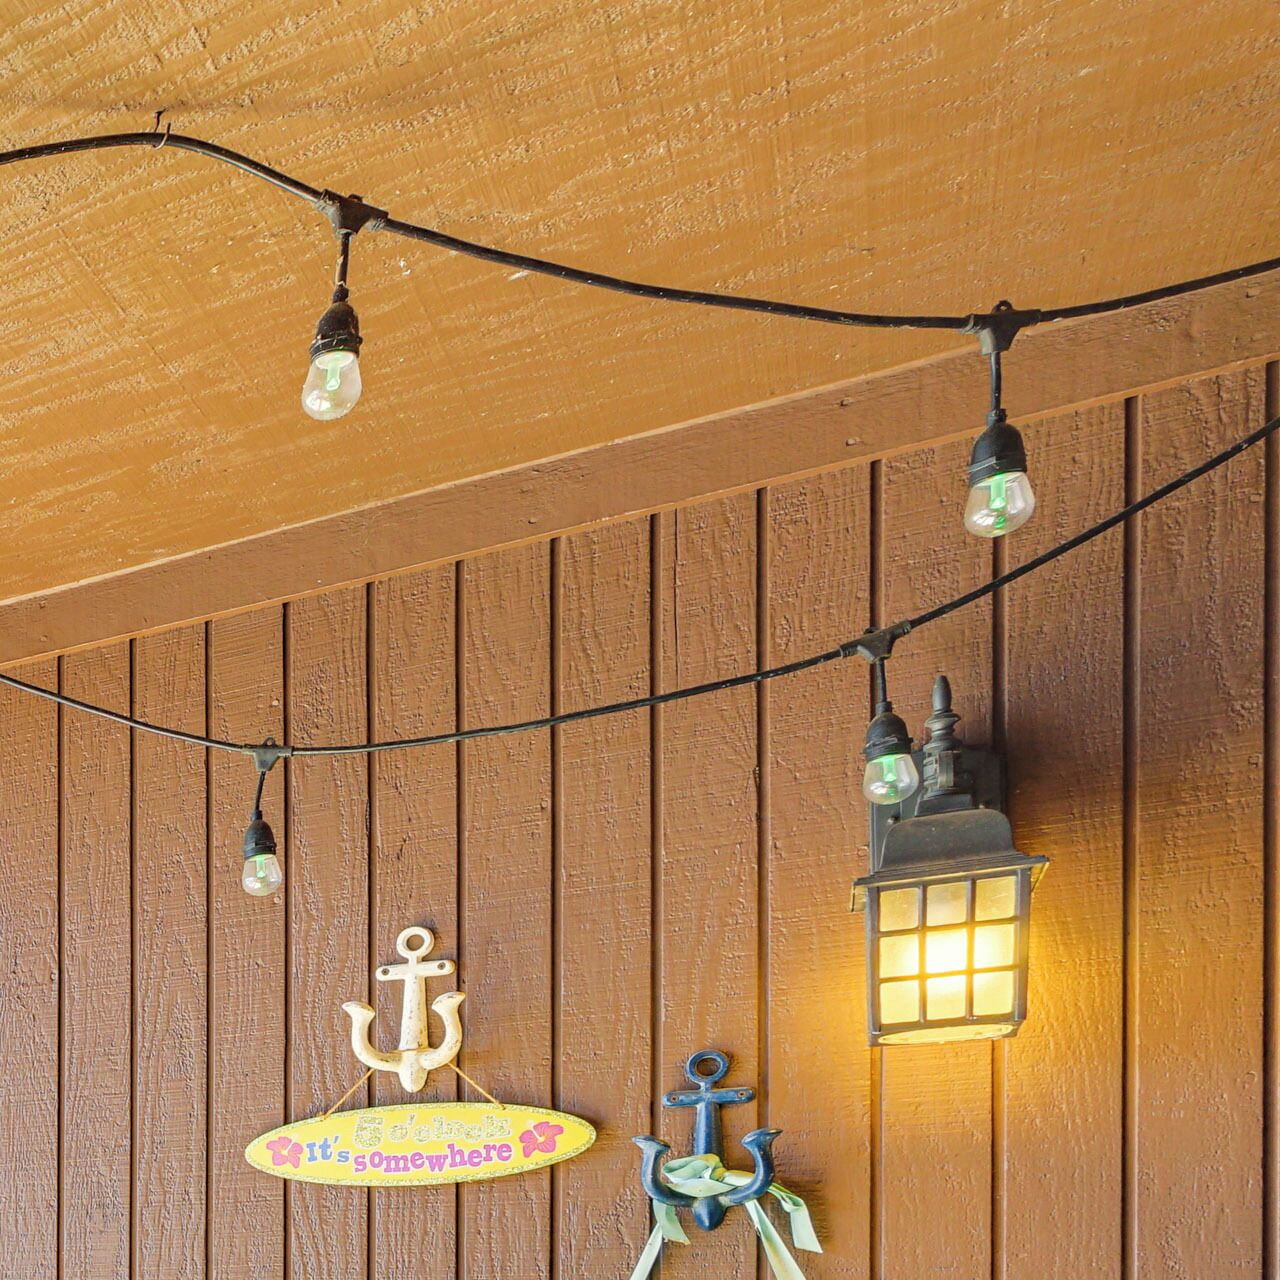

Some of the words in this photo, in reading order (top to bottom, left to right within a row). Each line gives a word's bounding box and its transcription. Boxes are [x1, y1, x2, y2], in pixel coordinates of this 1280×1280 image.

[353, 1116, 383, 1148] 5
[306, 1136, 350, 1163] It's
[354, 1142, 513, 1173] somewhere
